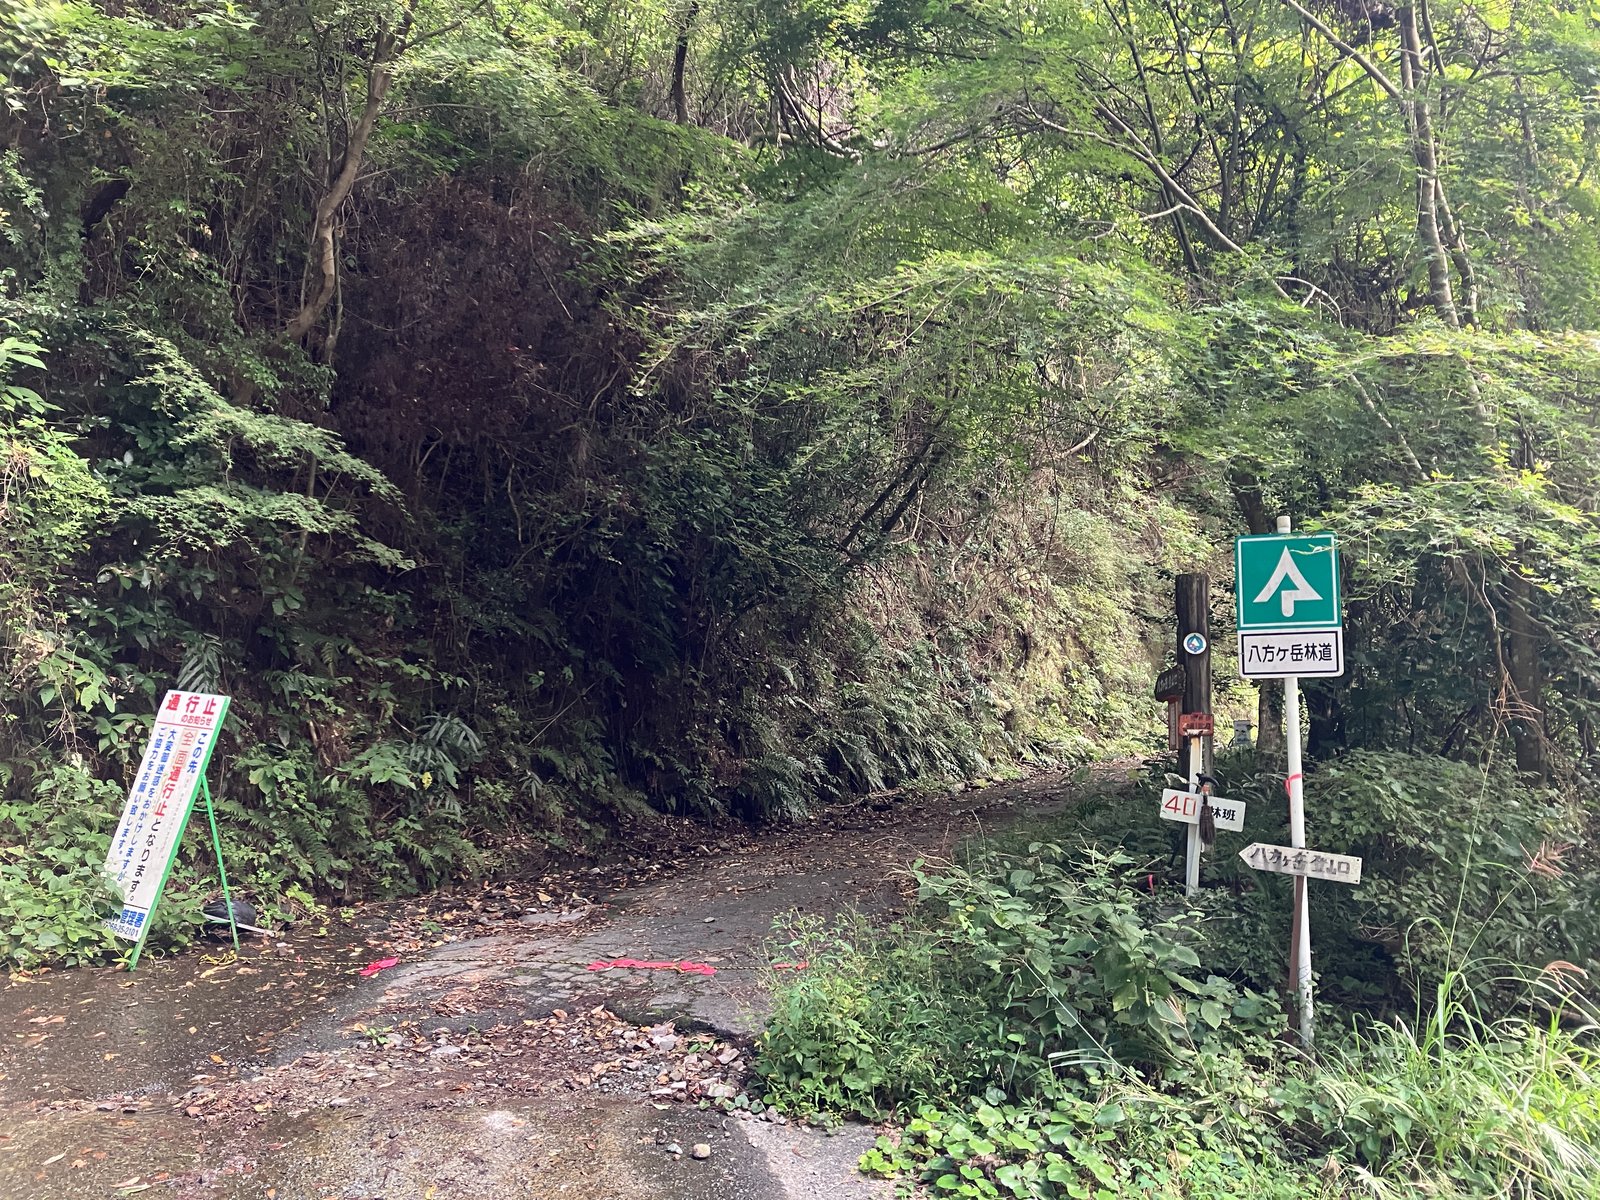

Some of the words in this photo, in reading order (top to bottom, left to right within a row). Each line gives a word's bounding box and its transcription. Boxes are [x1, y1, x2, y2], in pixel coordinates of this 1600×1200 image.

[165, 693, 217, 715] 通行止
[180, 714, 213, 727] のお知らせ
[186, 732, 209, 774] この先
[1164, 795, 1197, 817] 40
